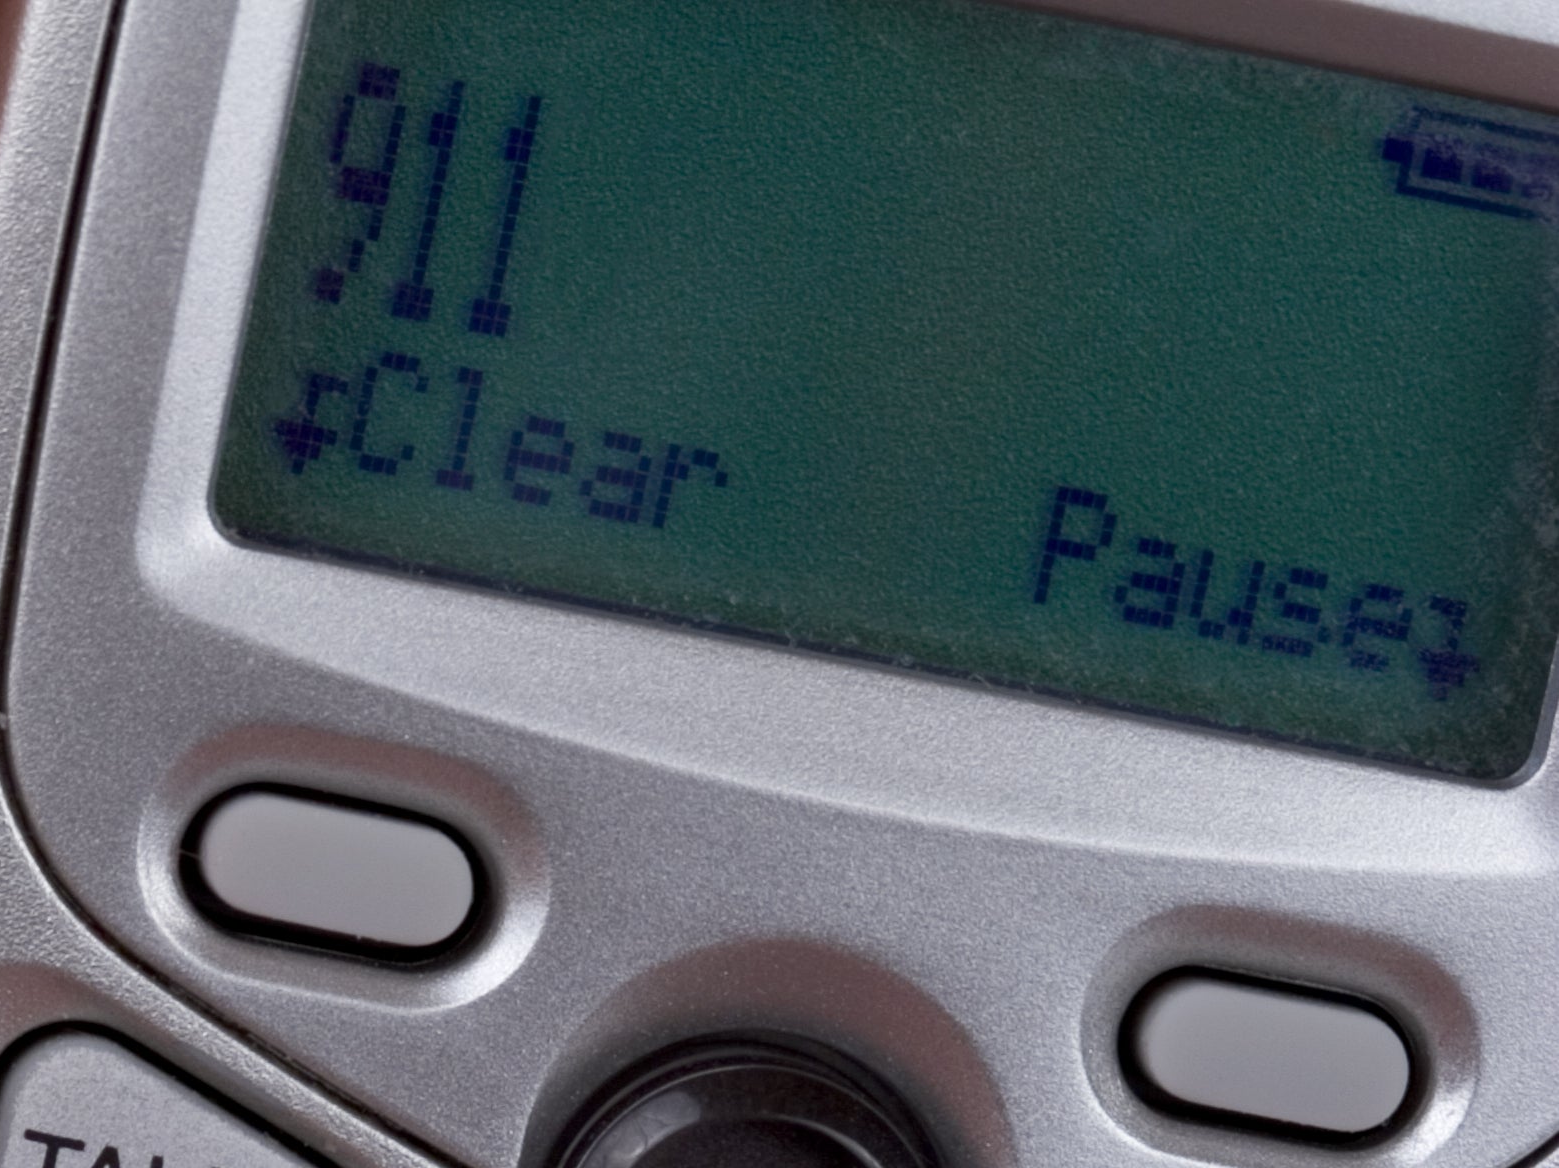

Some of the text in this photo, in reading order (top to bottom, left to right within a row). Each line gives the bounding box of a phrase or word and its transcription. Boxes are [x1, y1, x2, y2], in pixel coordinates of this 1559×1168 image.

[311, 60, 541, 337] 911
[348, 350, 729, 529] Clear
[1033, 484, 1414, 673] Pause
